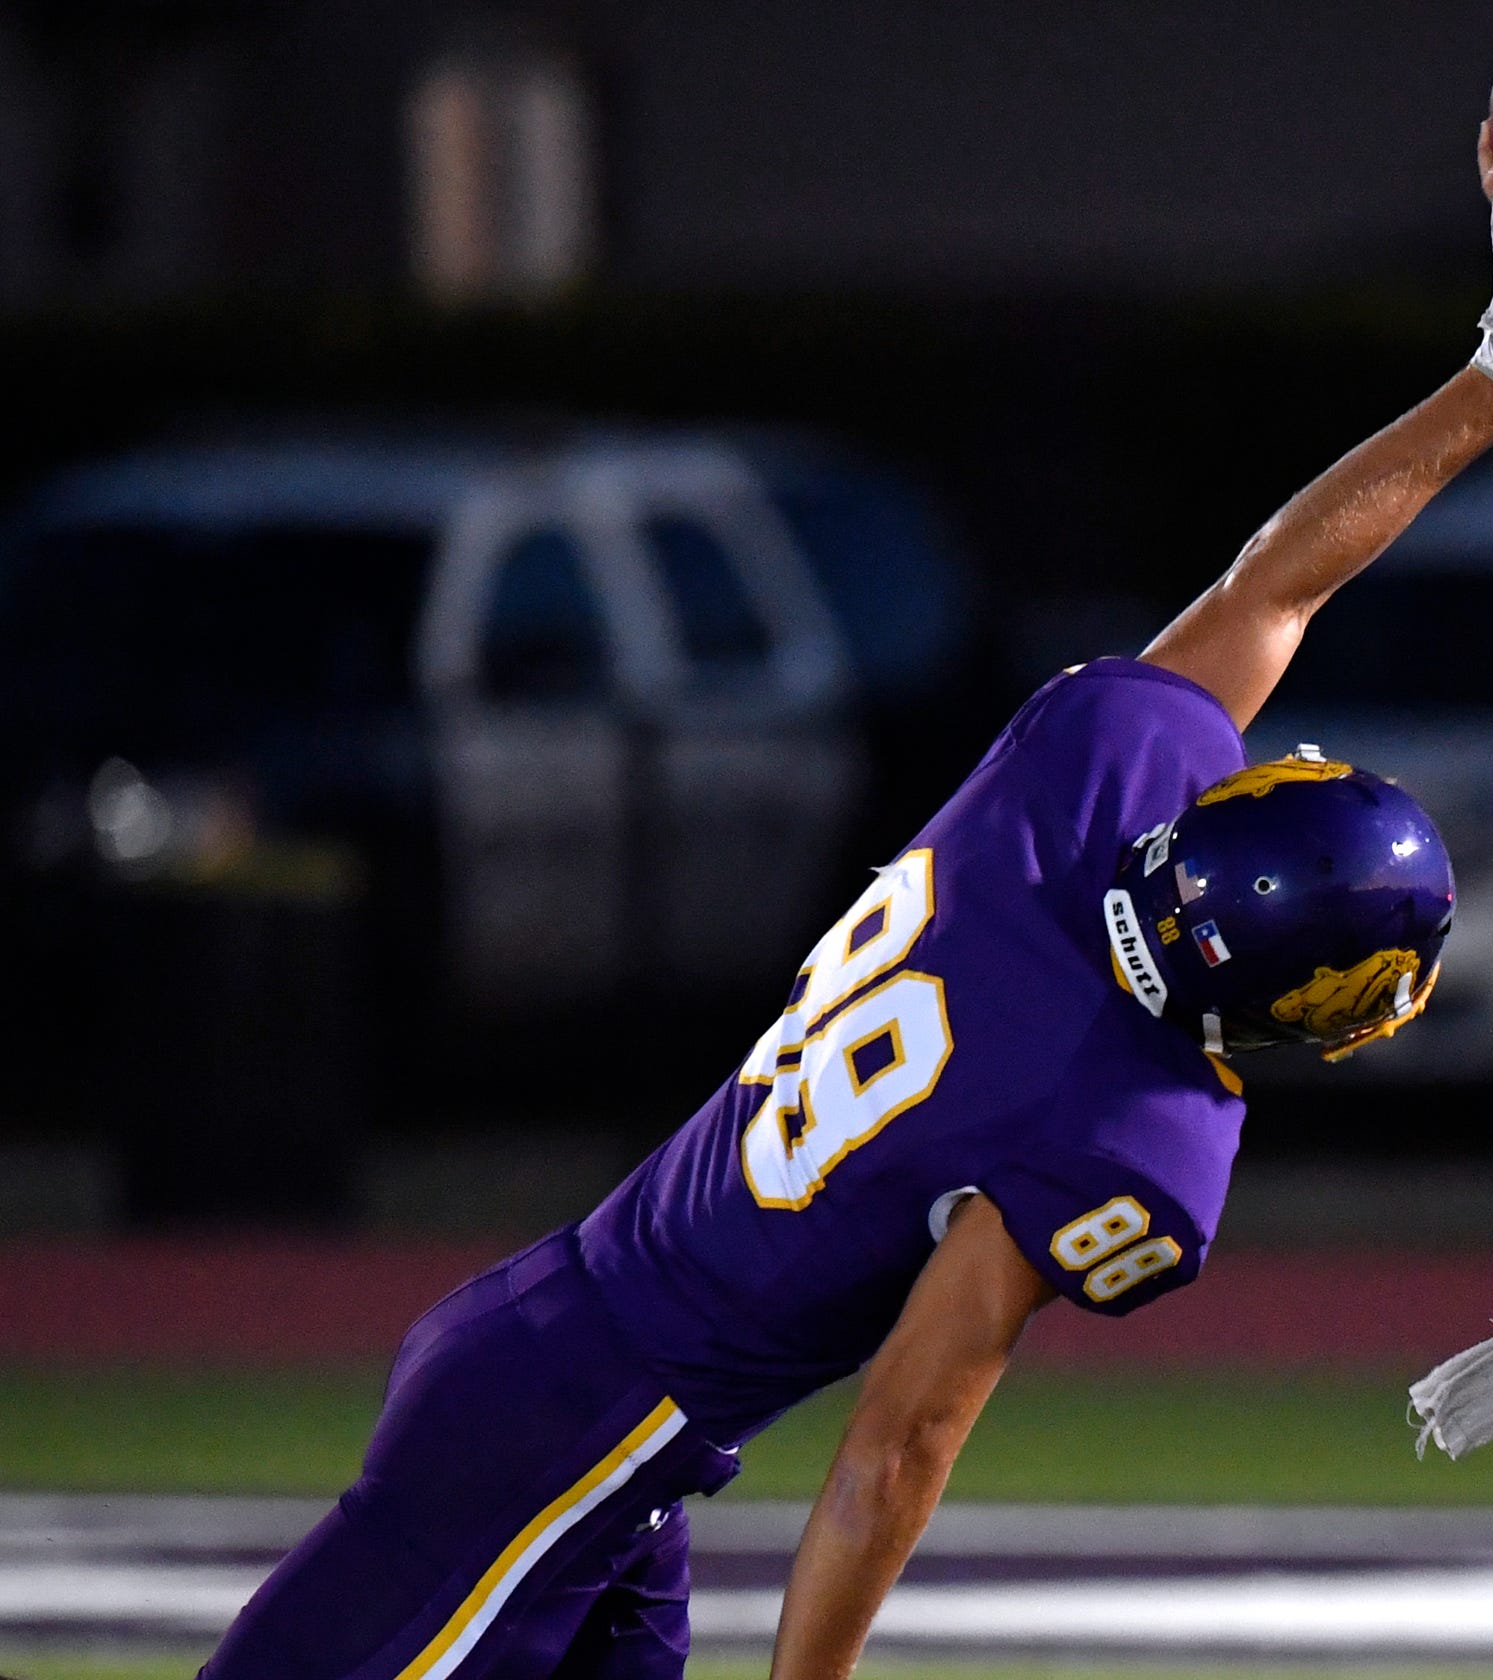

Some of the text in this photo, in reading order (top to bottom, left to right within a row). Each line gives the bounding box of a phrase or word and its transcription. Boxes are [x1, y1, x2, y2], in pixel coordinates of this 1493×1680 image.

[1112, 901, 1160, 996] schutt
[1157, 915, 1181, 946] 88
[1049, 1195, 1183, 1303] 88
